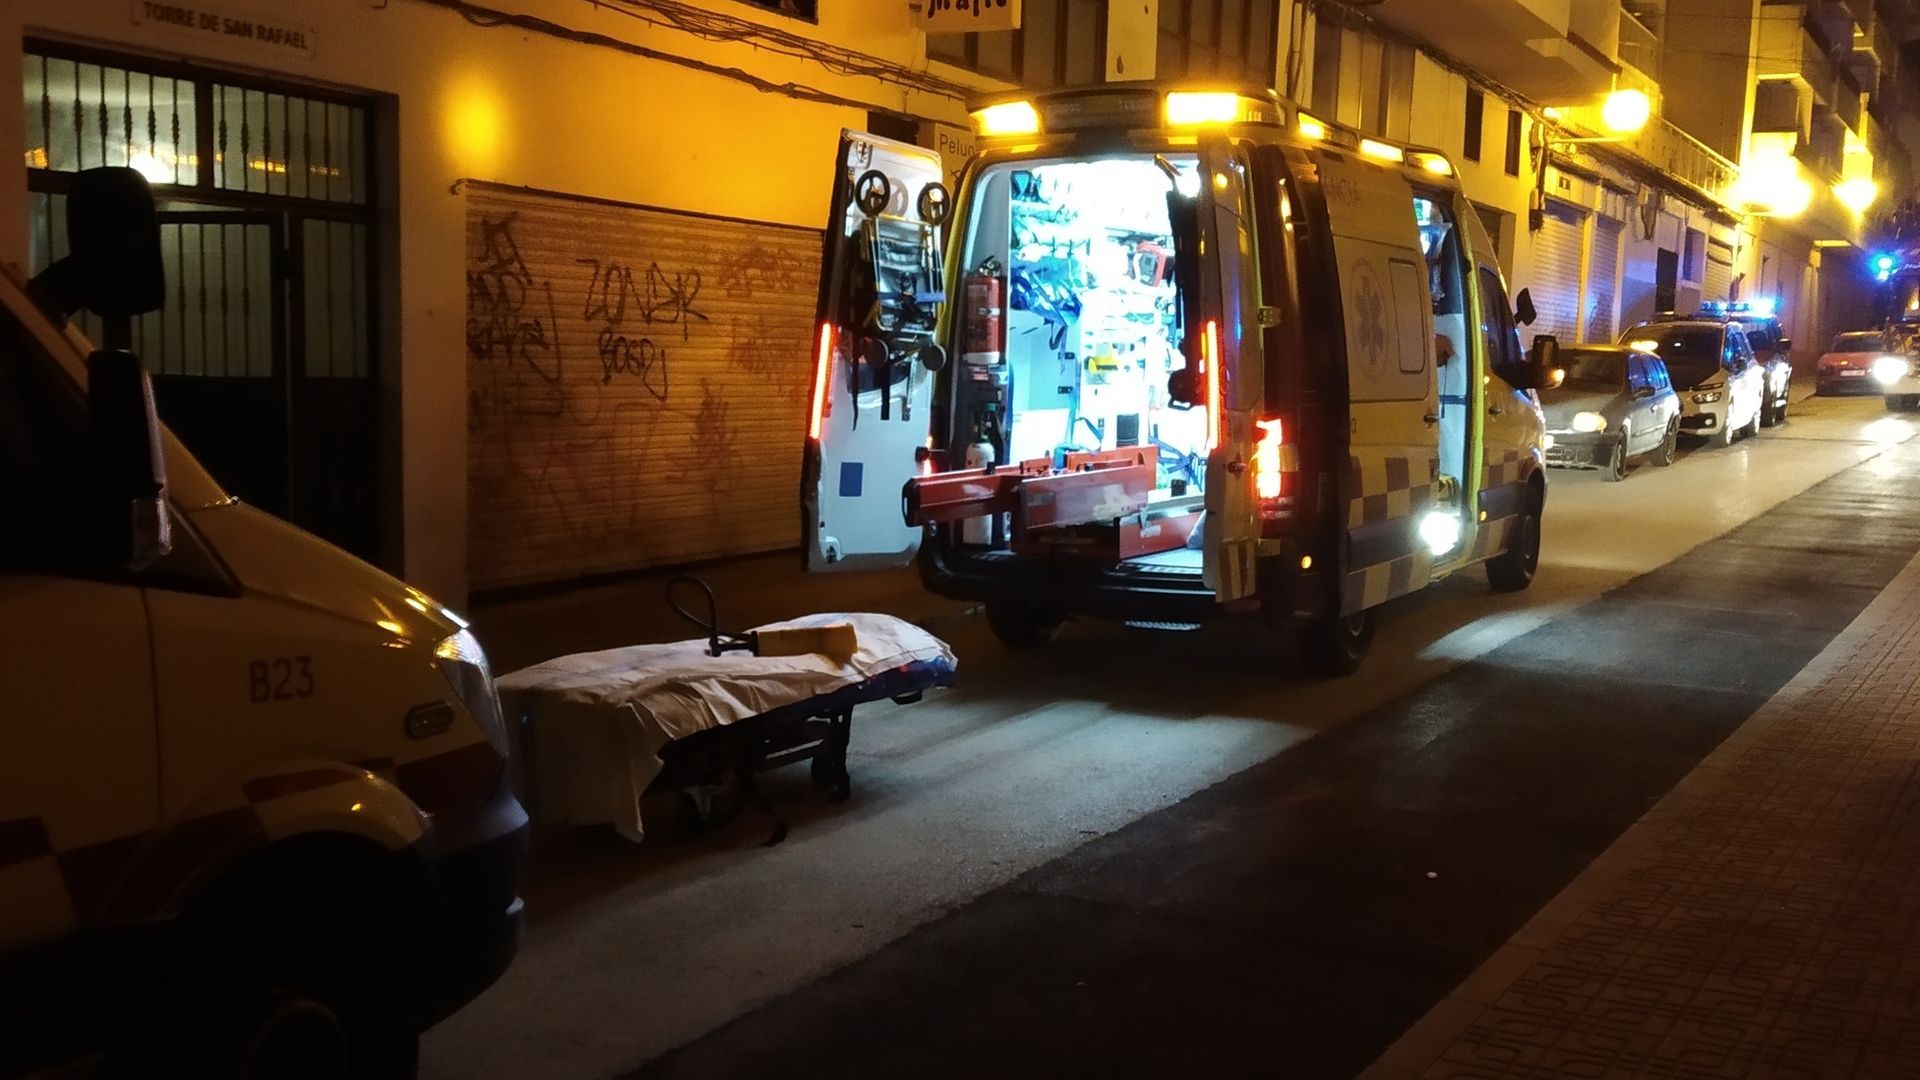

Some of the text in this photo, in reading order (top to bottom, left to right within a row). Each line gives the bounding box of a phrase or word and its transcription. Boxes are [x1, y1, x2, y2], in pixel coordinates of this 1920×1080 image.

[144, 1, 308, 50] TORRE DE SAN RAFAEL
[249, 655, 315, 703] B23
